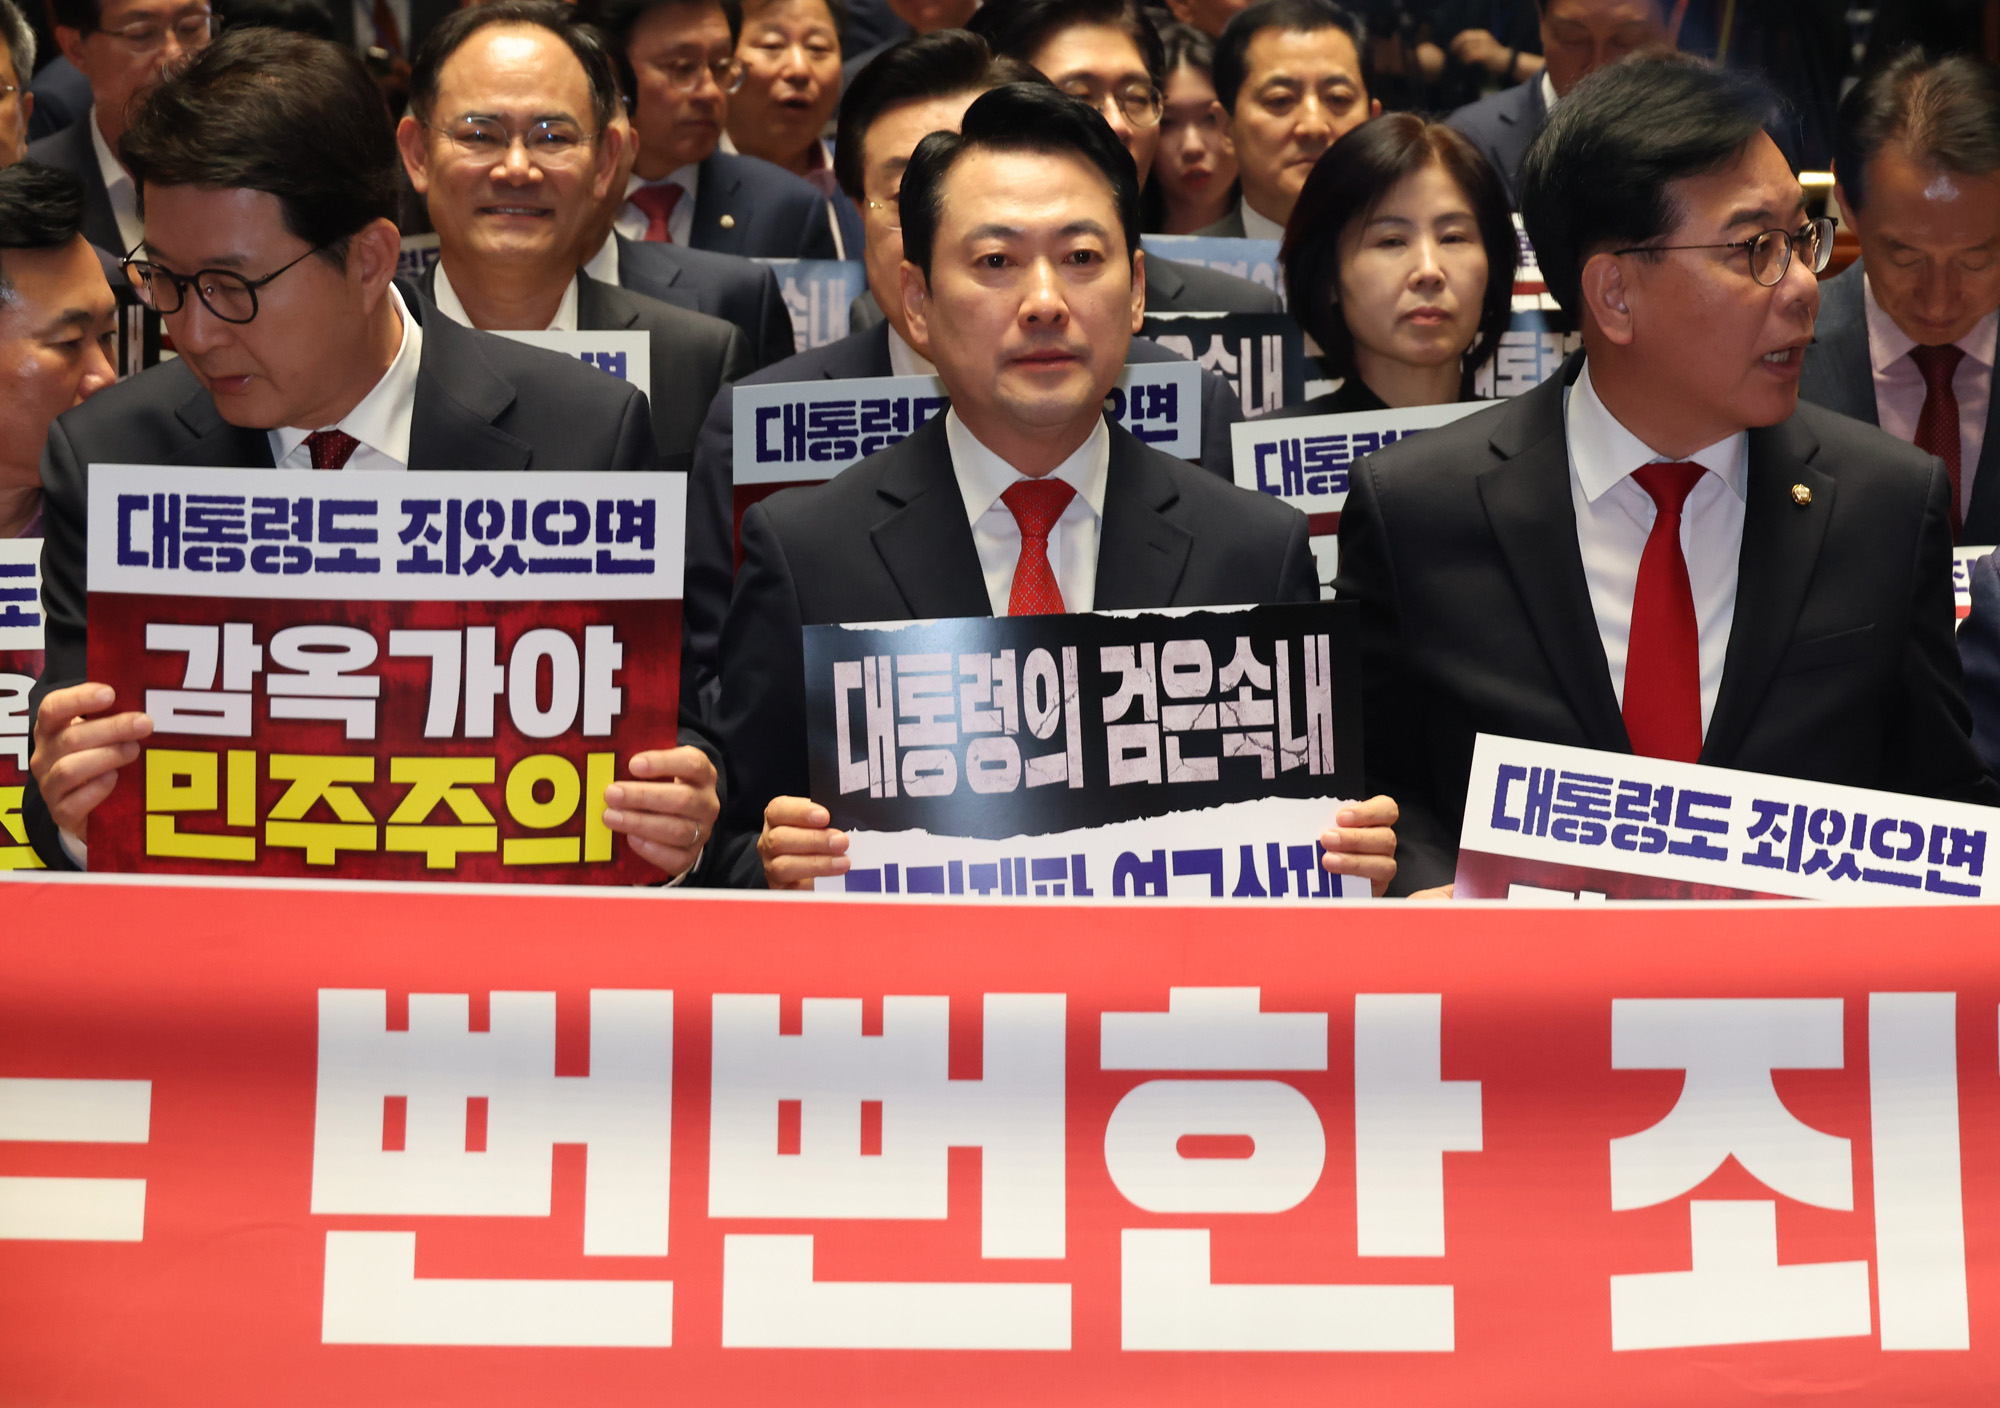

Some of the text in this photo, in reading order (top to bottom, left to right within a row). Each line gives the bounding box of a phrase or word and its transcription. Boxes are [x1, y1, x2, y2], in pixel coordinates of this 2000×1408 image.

[117, 493, 657, 578] 대통령도 죄있으면
[833, 633, 1335, 798] 대통령의 검은속내
[145, 748, 616, 869] 민주주의
[1491, 763, 1988, 898] 대통령도 죄있으면
[311, 986, 1484, 1353] 뻔뻔한
[1609, 991, 2000, 1352] 죄
